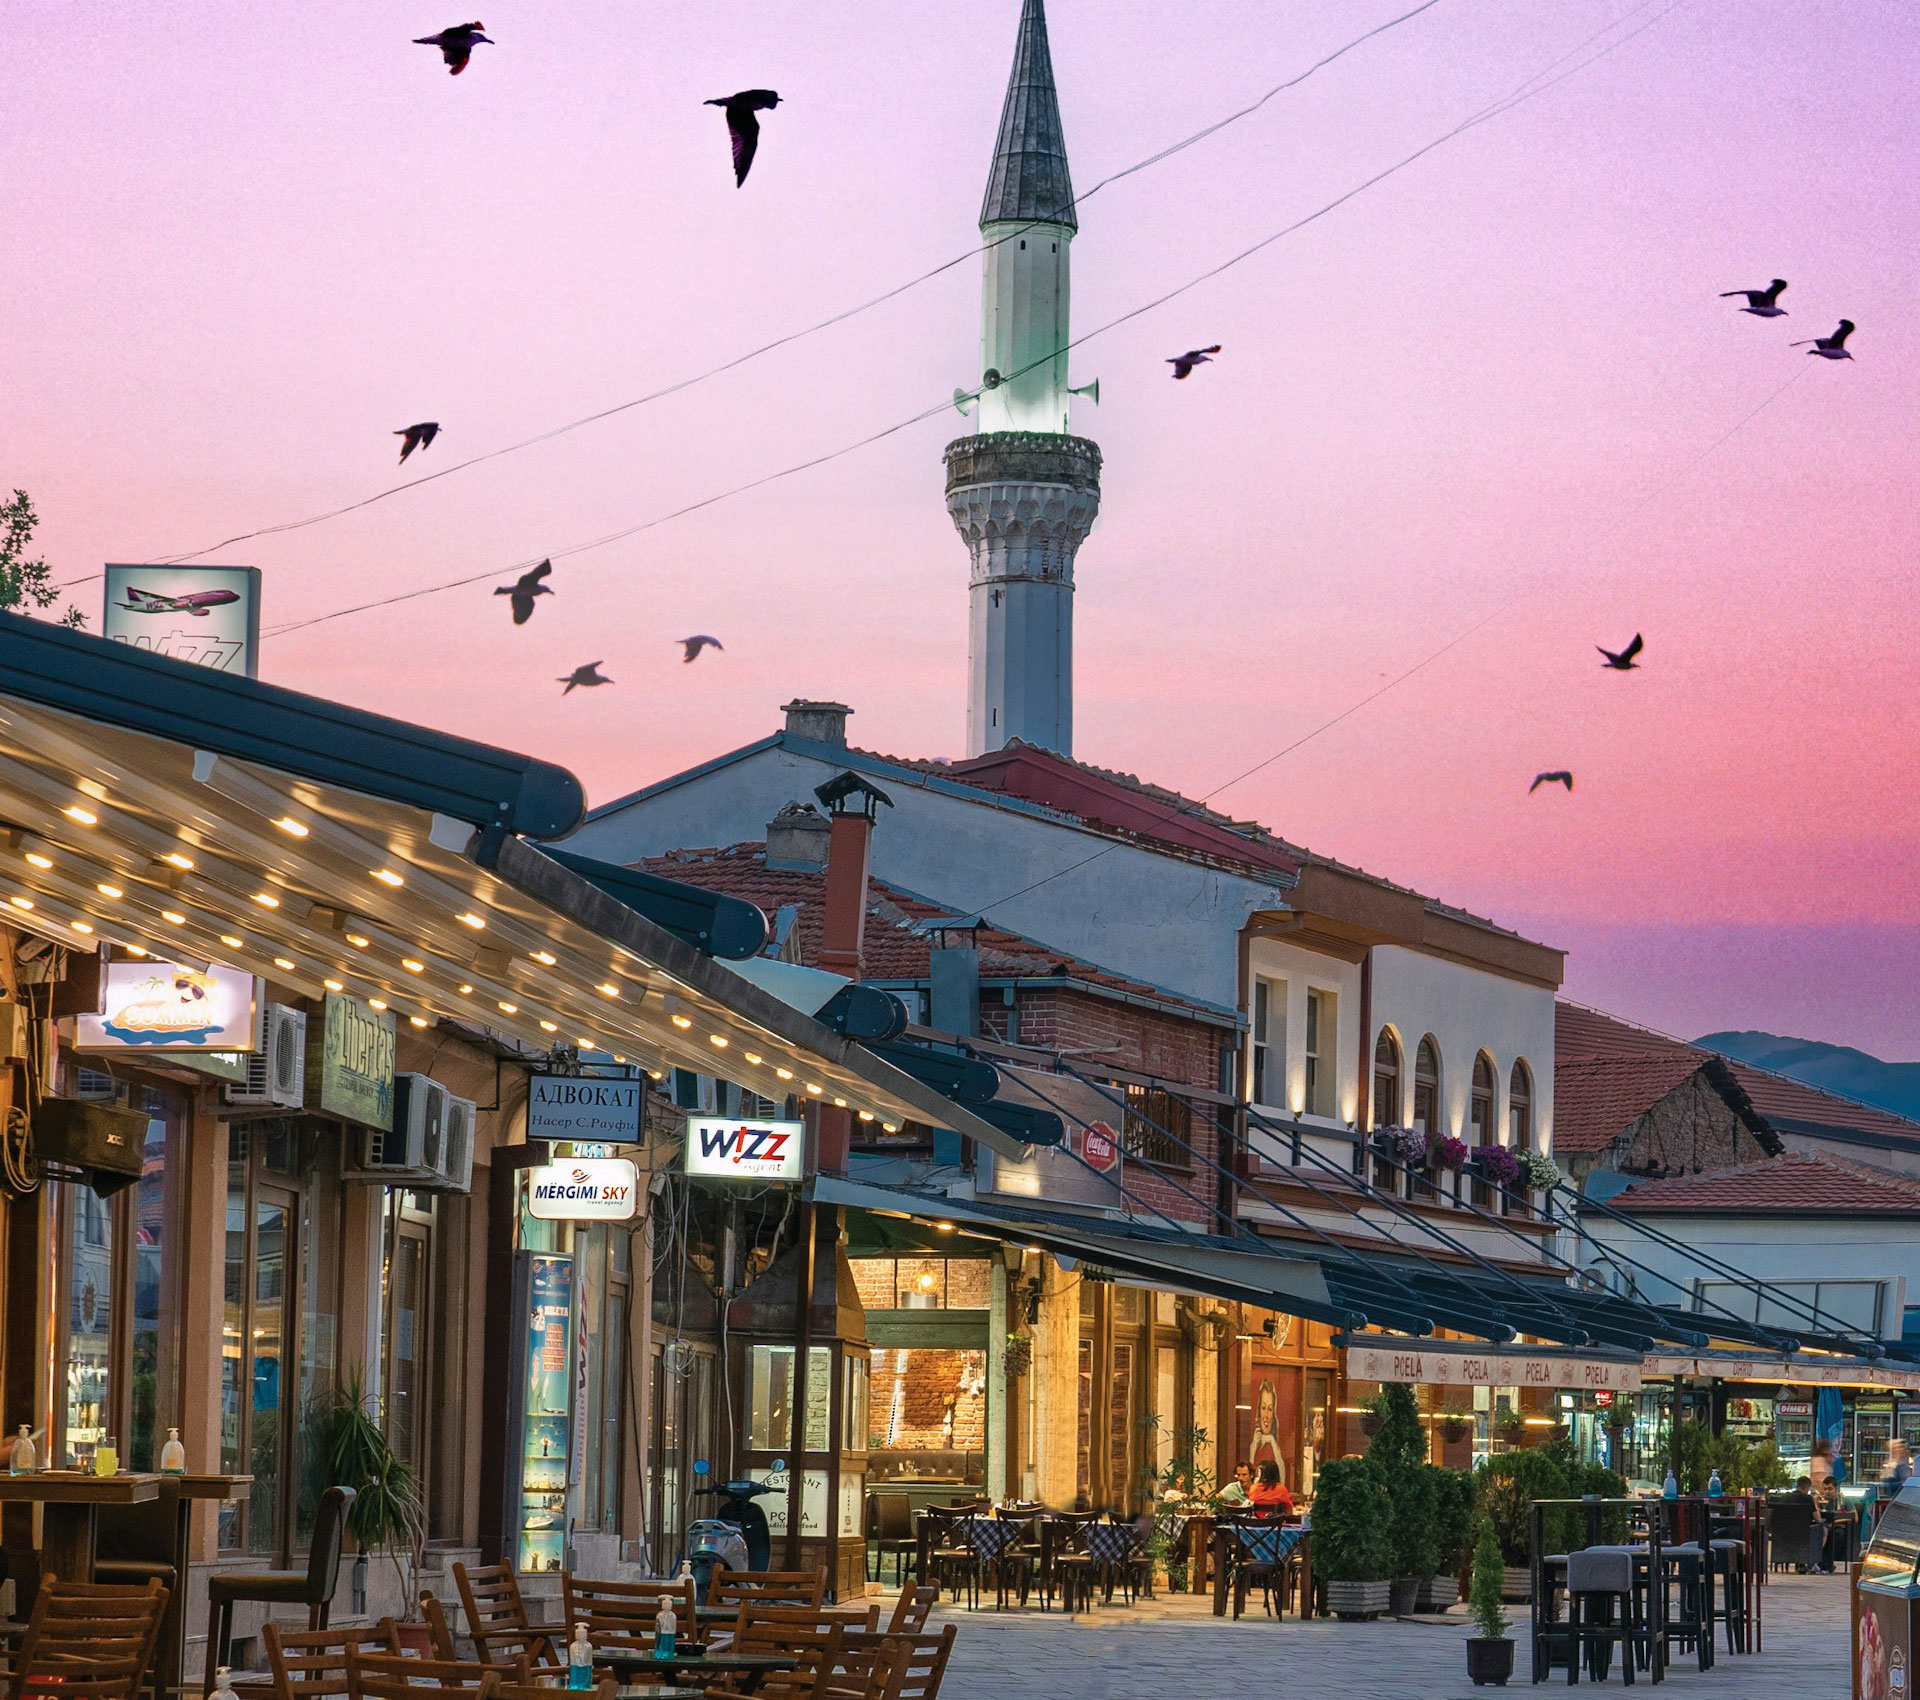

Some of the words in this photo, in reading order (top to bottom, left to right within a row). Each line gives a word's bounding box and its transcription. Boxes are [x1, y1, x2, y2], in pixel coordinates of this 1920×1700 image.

[534, 1084, 638, 1108] АДВОКАТ
[531, 1115, 572, 1129] Насер
[535, 1183, 598, 1200] MËRGIMI
[601, 1186, 629, 1201] SKY
[1462, 1359, 1489, 1382] PÇELA
[770, 1511, 809, 1523] PÇA
